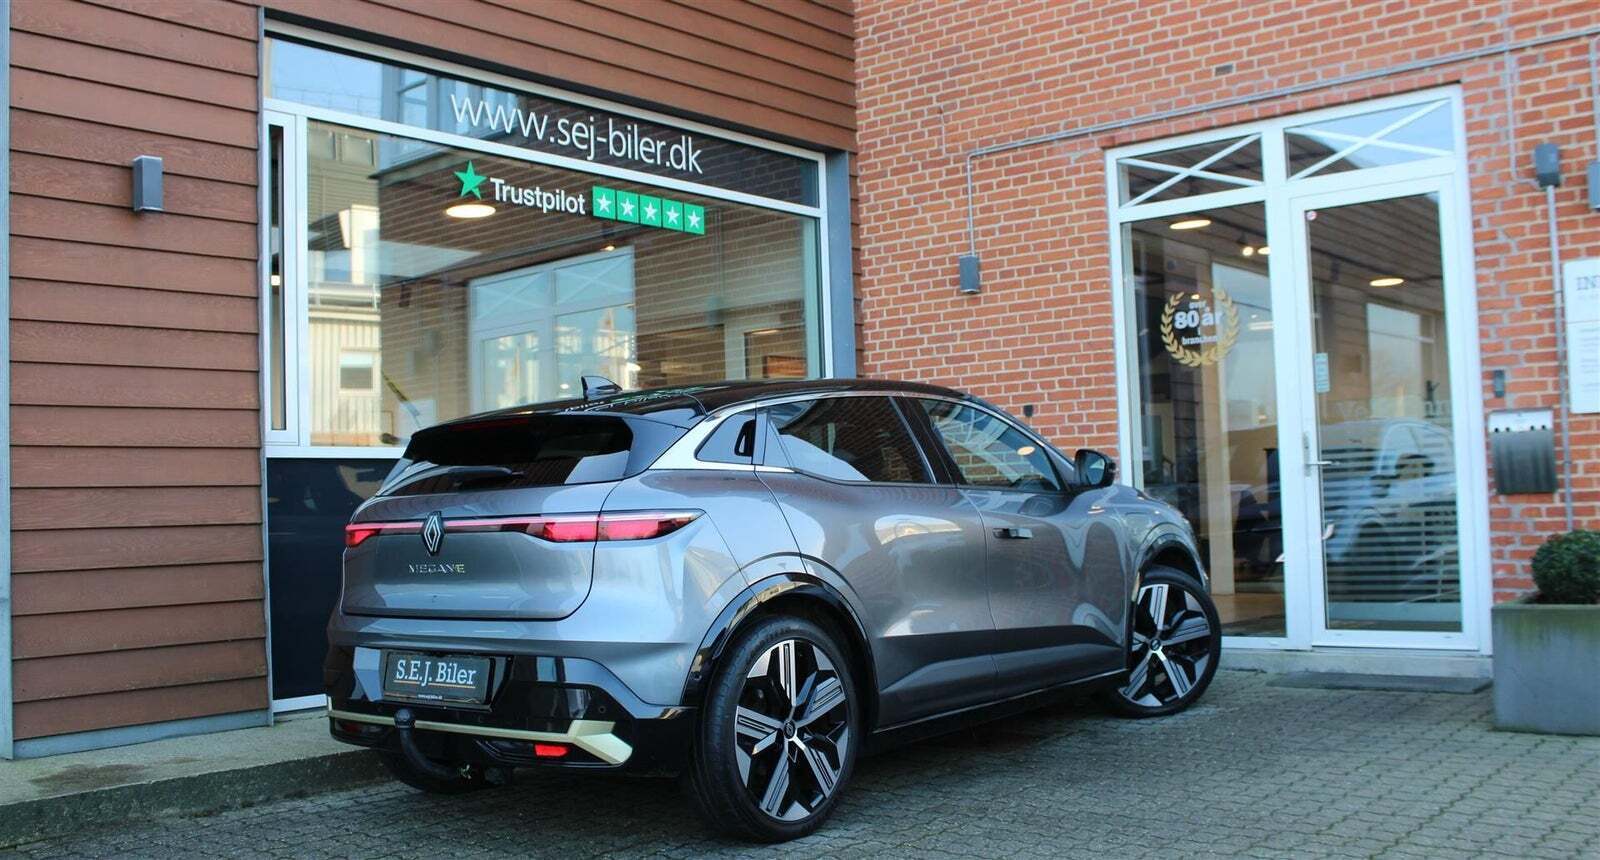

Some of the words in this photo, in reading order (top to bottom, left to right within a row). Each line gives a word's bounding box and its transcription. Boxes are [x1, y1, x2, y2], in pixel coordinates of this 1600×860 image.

[450, 94, 703, 174] www.sej-biler.dk
[490, 177, 586, 215] Trustpilot
[1174, 310, 1200, 329] 80
[1202, 306, 1222, 325] år
[396, 659, 433, 686] S.E.J.
[436, 661, 477, 685] Biler
